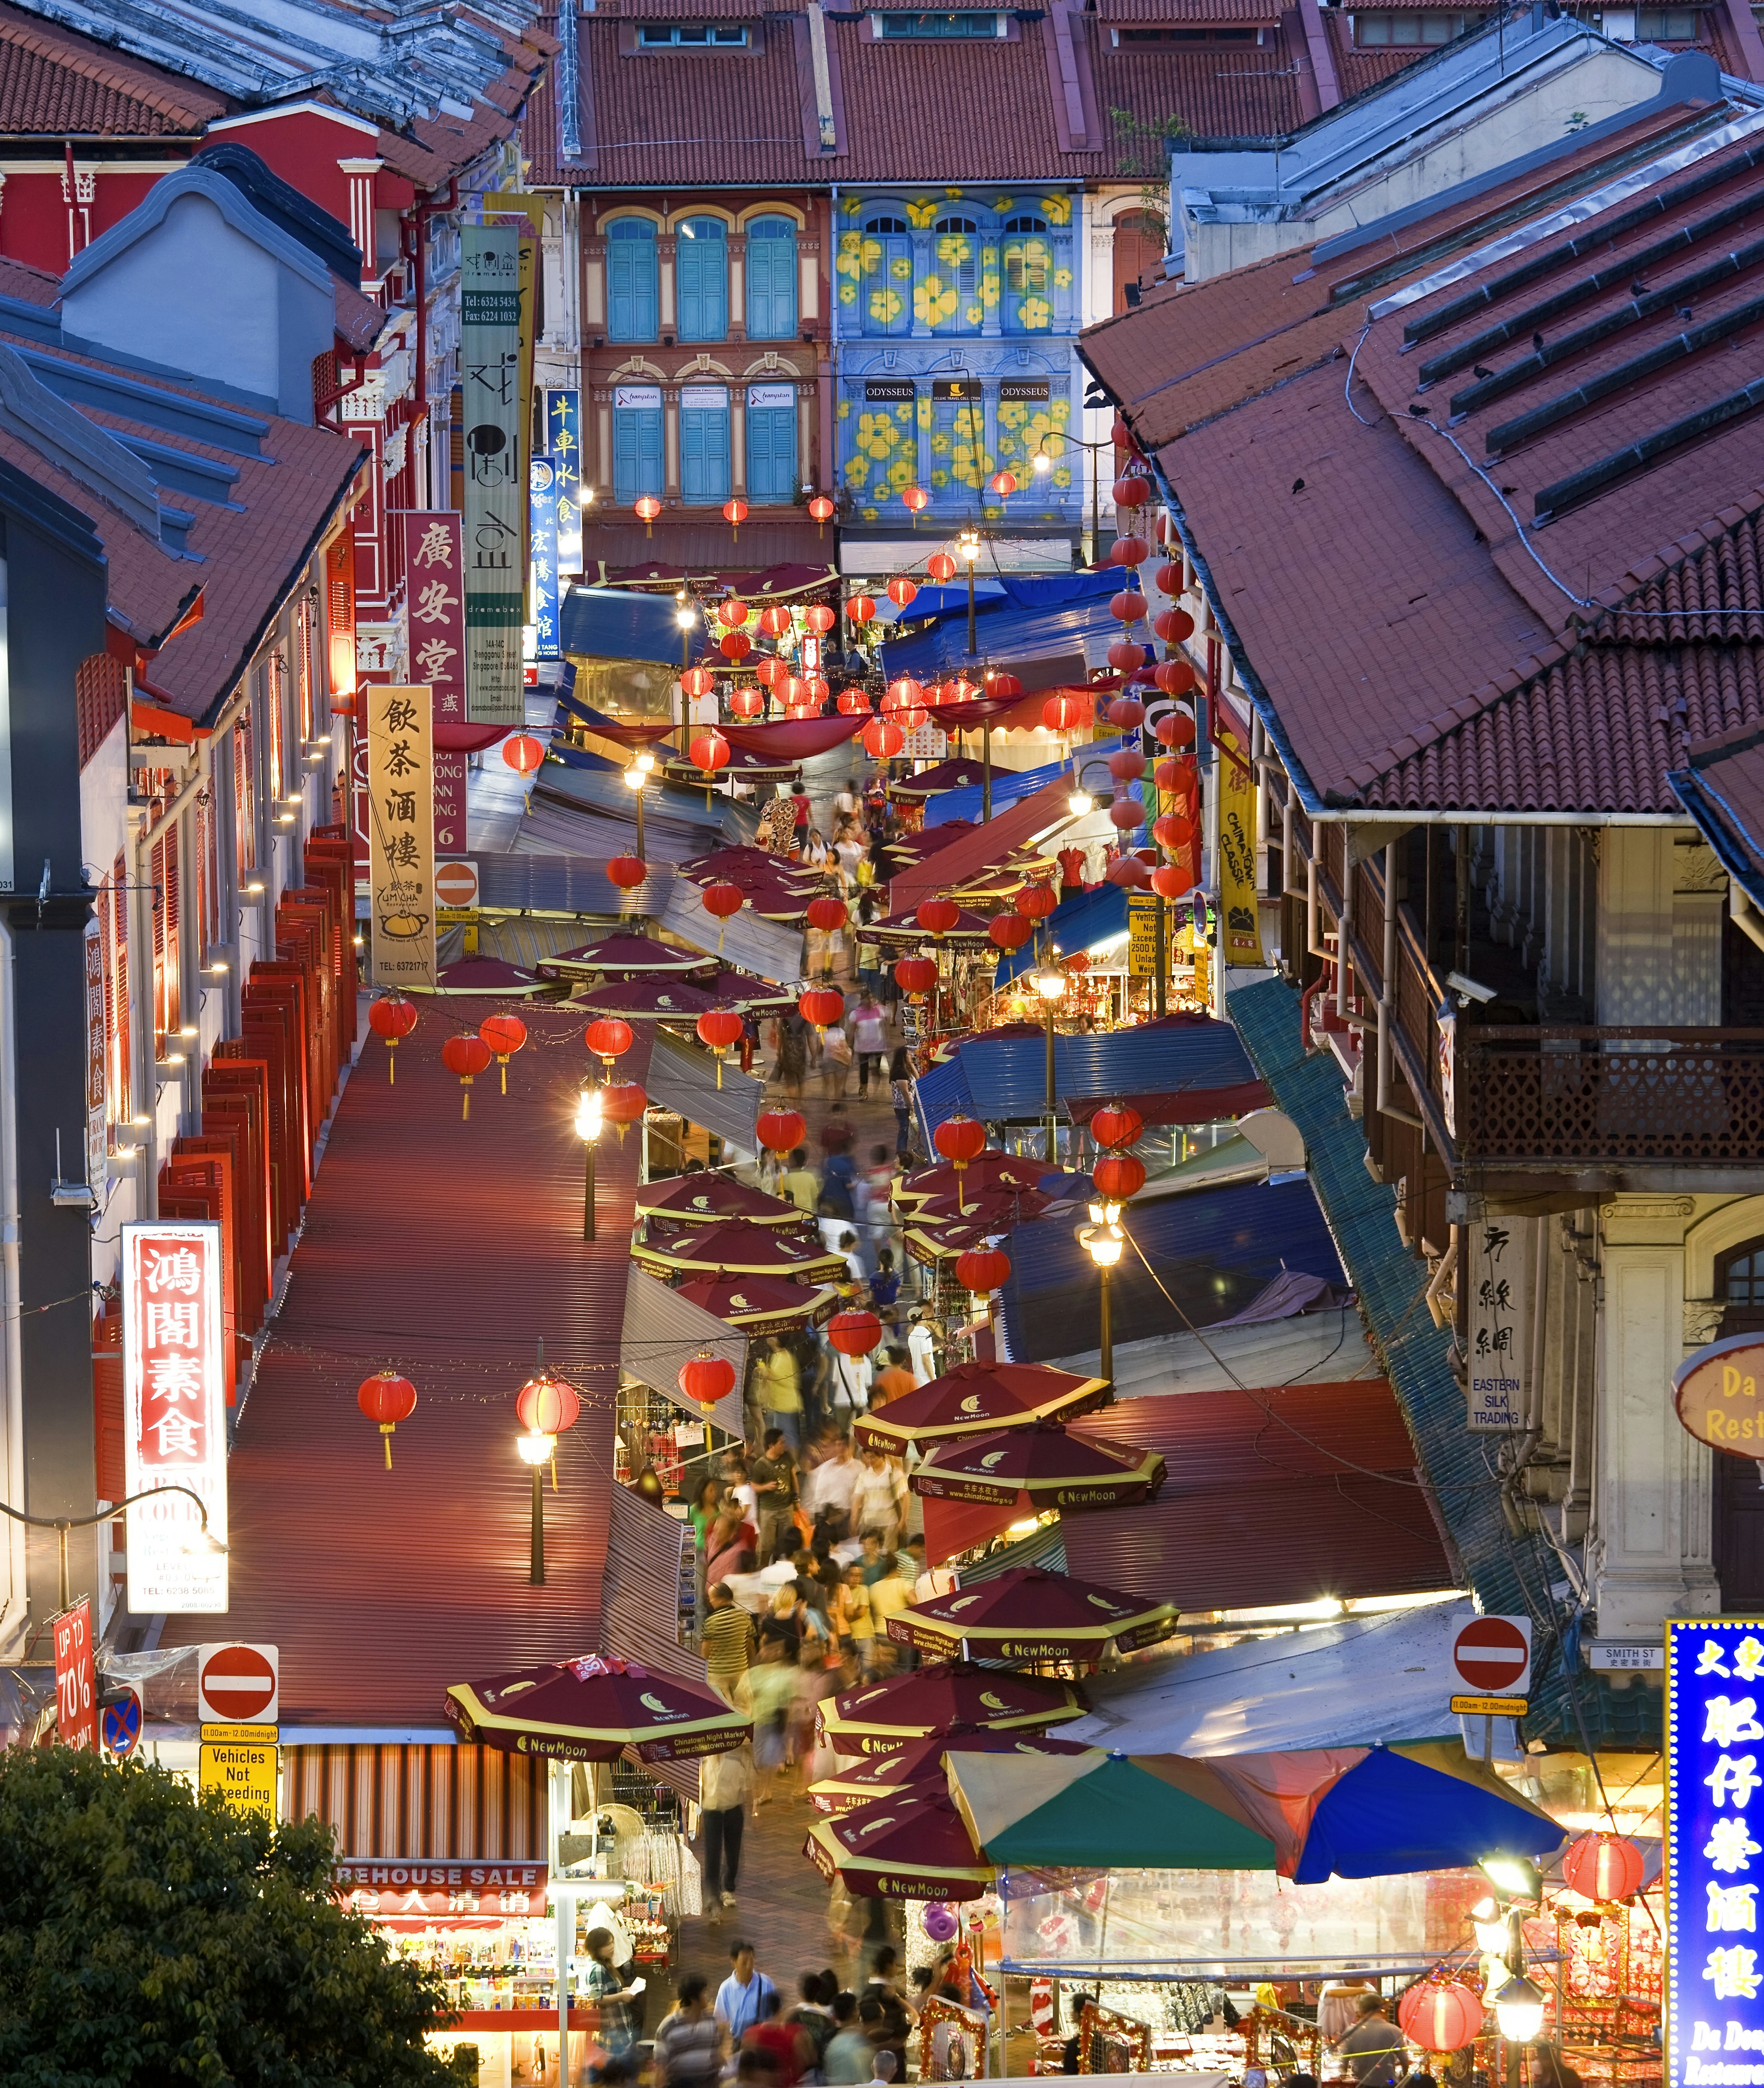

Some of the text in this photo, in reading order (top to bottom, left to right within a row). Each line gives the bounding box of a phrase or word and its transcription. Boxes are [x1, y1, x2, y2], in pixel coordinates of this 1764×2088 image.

[465, 296, 516, 307] Tel: 6324 5434
[465, 311, 516, 321] Fax: 6224 1032
[551, 395, 581, 555] 牛車水食
[808, 586, 829, 597] NewMoon
[412, 521, 459, 684] 廣安堂
[468, 605, 521, 613] dramabox
[486, 640, 505, 648] 14A-14C
[474, 650, 500, 660] Trengganu
[473, 662, 498, 672] Singapore
[471, 704, 522, 712] dramabox@pacific.net.sg
[434, 765, 462, 778] ONG
[380, 698, 421, 869] 飲茶酒樓
[1227, 812, 1257, 891] CHINATOWN
[1221, 833, 1242, 890] CLASSIC
[390, 880, 415, 891] 飲茶
[377, 886, 418, 913] YUM CHA
[1135, 913, 1156, 921] Vehic
[1143, 923, 1156, 932] Not
[1131, 944, 1150, 953] 2500
[1135, 954, 1156, 963] Unlad
[379, 961, 428, 971] TEL: 63721717
[1138, 965, 1155, 975] Weig
[87, 944, 104, 1101] 鴻閣素食
[729, 1307, 762, 1315] NewMoon
[144, 1247, 205, 1457] 鴻閣素食
[1473, 1378, 1520, 1391] EASTERN
[1722, 1366, 1756, 1398] Da
[1485, 1396, 1508, 1408] SILK
[954, 1412, 990, 1422] NewMoon
[1473, 1412, 1519, 1424] TRADING
[874, 1435, 896, 1451] NewMoon
[963, 1465, 995, 1474] NewMoon
[138, 1476, 215, 1496] GRAND
[963, 1483, 999, 1496] 牛车水夜市
[949, 1490, 1013, 1505] www.chinatown.org.sg
[1067, 1490, 1116, 1503] NewMoon
[930, 1608, 955, 1619] NewMoon
[58, 1618, 84, 1658] UP TO
[913, 1630, 944, 1645] Chinatown Night
[1014, 1644, 1069, 1657] NewMoon
[1606, 1649, 1655, 1658] SMITH ST
[58, 1657, 90, 1724] 70%
[988, 1708, 1025, 1718] NewMoon
[1452, 1700, 1527, 1713] 11.00am-12.00midnight
[653, 1712, 690, 1722] NewMoon
[203, 1728, 277, 1739] 11.00am-12.00midnight
[674, 1731, 746, 1747] Chinatown Night Market
[531, 1738, 587, 1757] NewMoon
[212, 1748, 265, 1764] Vehicles
[226, 1767, 250, 1781] Not
[336, 1868, 537, 1886] REHOUSE SALE
[891, 1879, 948, 1898] NewMoon
[1690, 2021, 1722, 2051] Da
